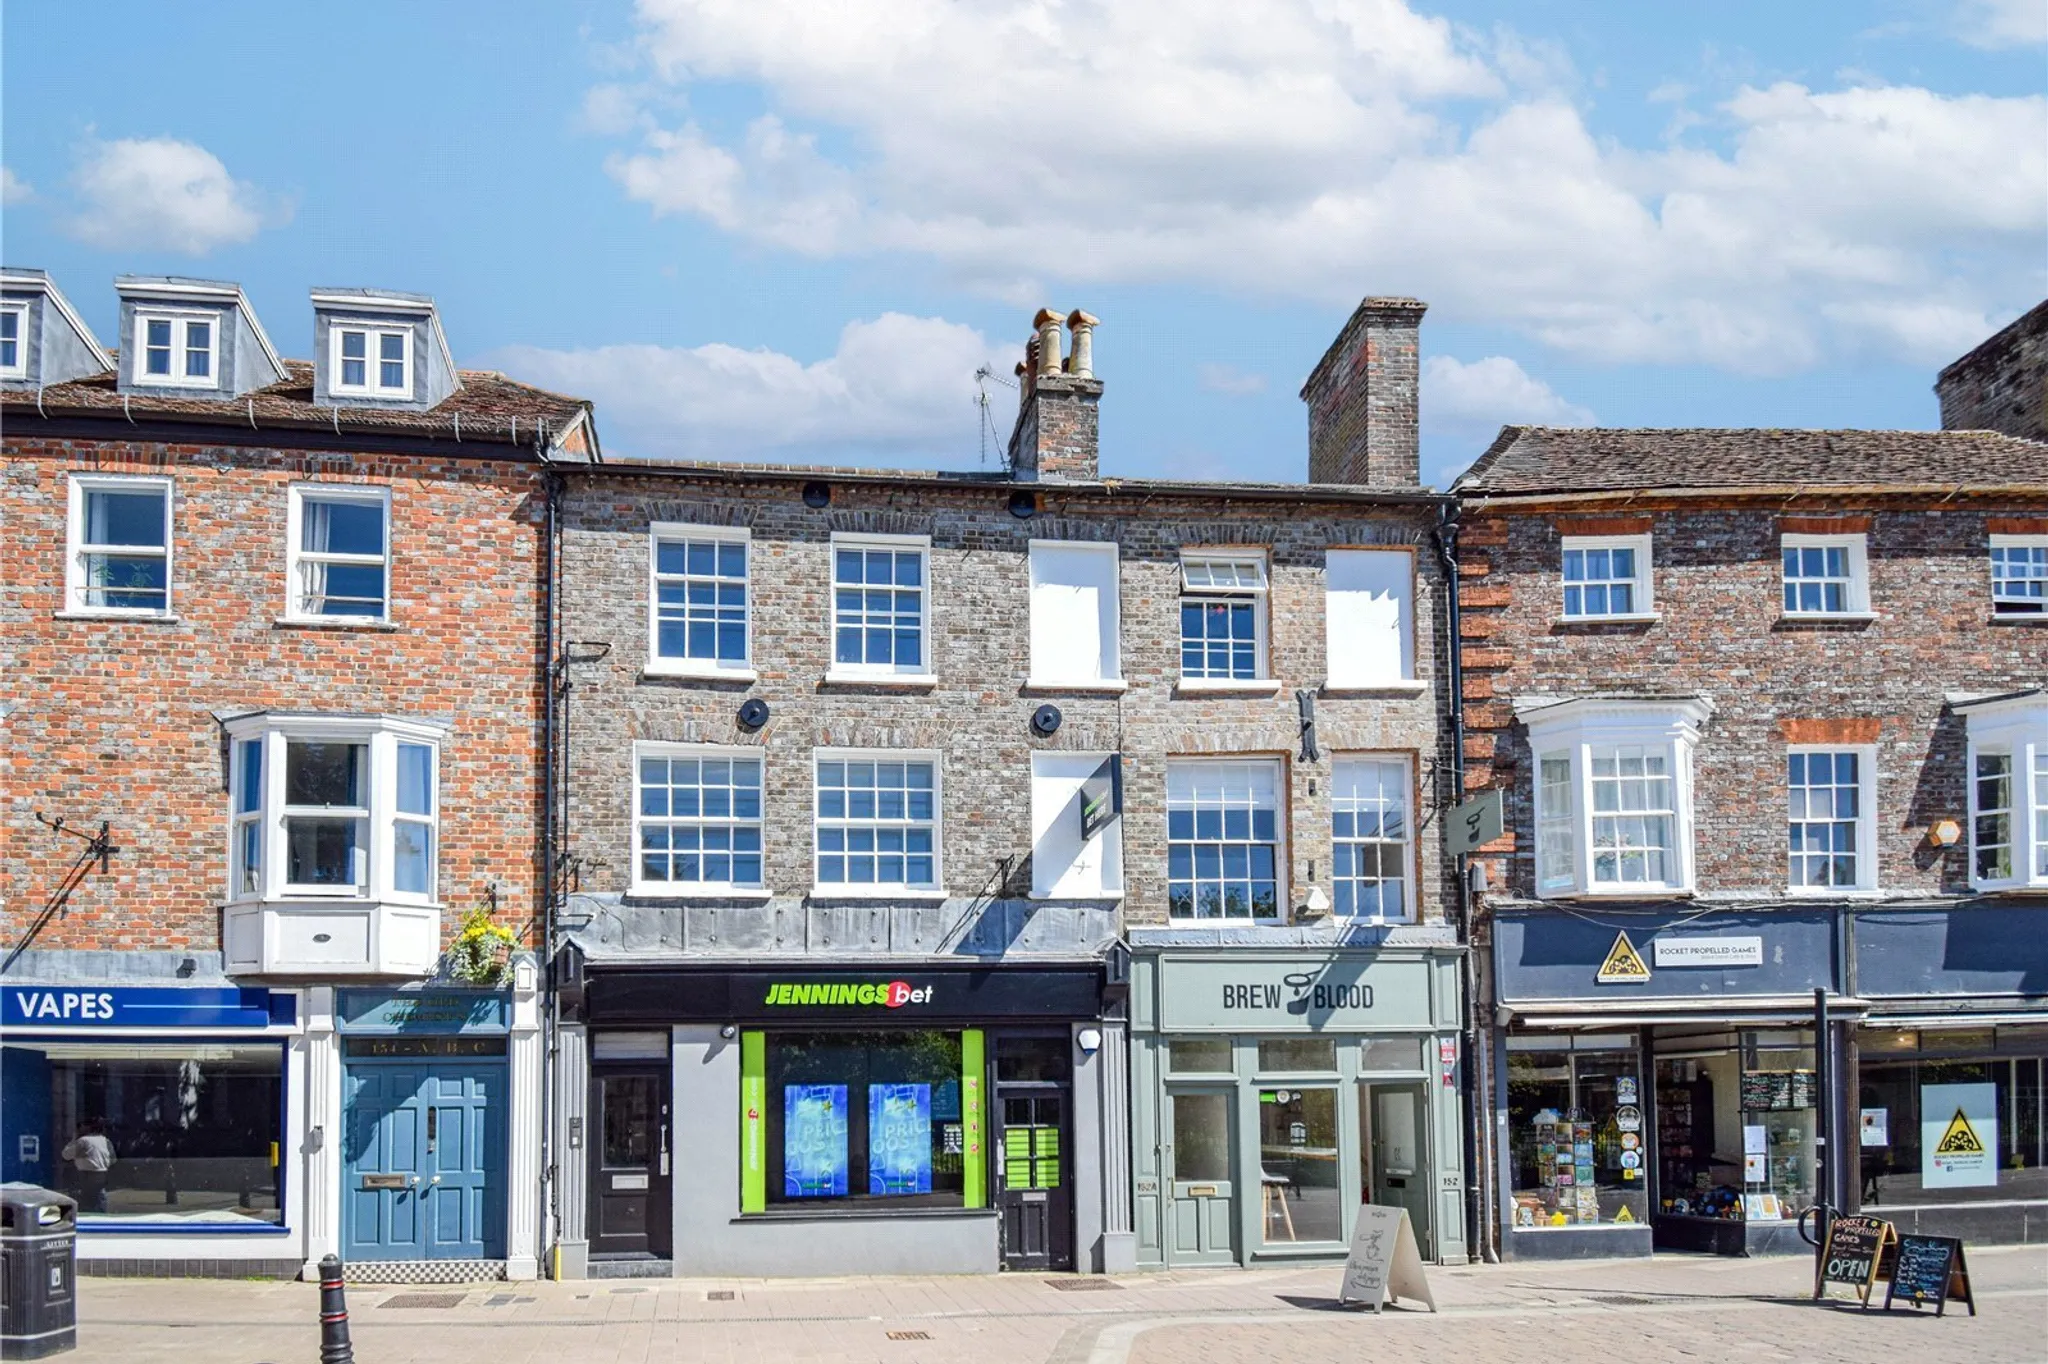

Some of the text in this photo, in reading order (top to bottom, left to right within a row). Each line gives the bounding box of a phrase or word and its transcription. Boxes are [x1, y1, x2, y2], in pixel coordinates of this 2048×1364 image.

[1660, 946, 1757, 955] ROCKET PROPELLED GAMES
[1223, 984, 1374, 1009] BREW BLOOD
[16, 992, 114, 1019] VAPES
[1443, 1177, 1458, 1186] 152
[1835, 1219, 1870, 1229] ROCKET
[1834, 1233, 1860, 1244] GAMES
[1827, 1258, 1870, 1277] OPEN
